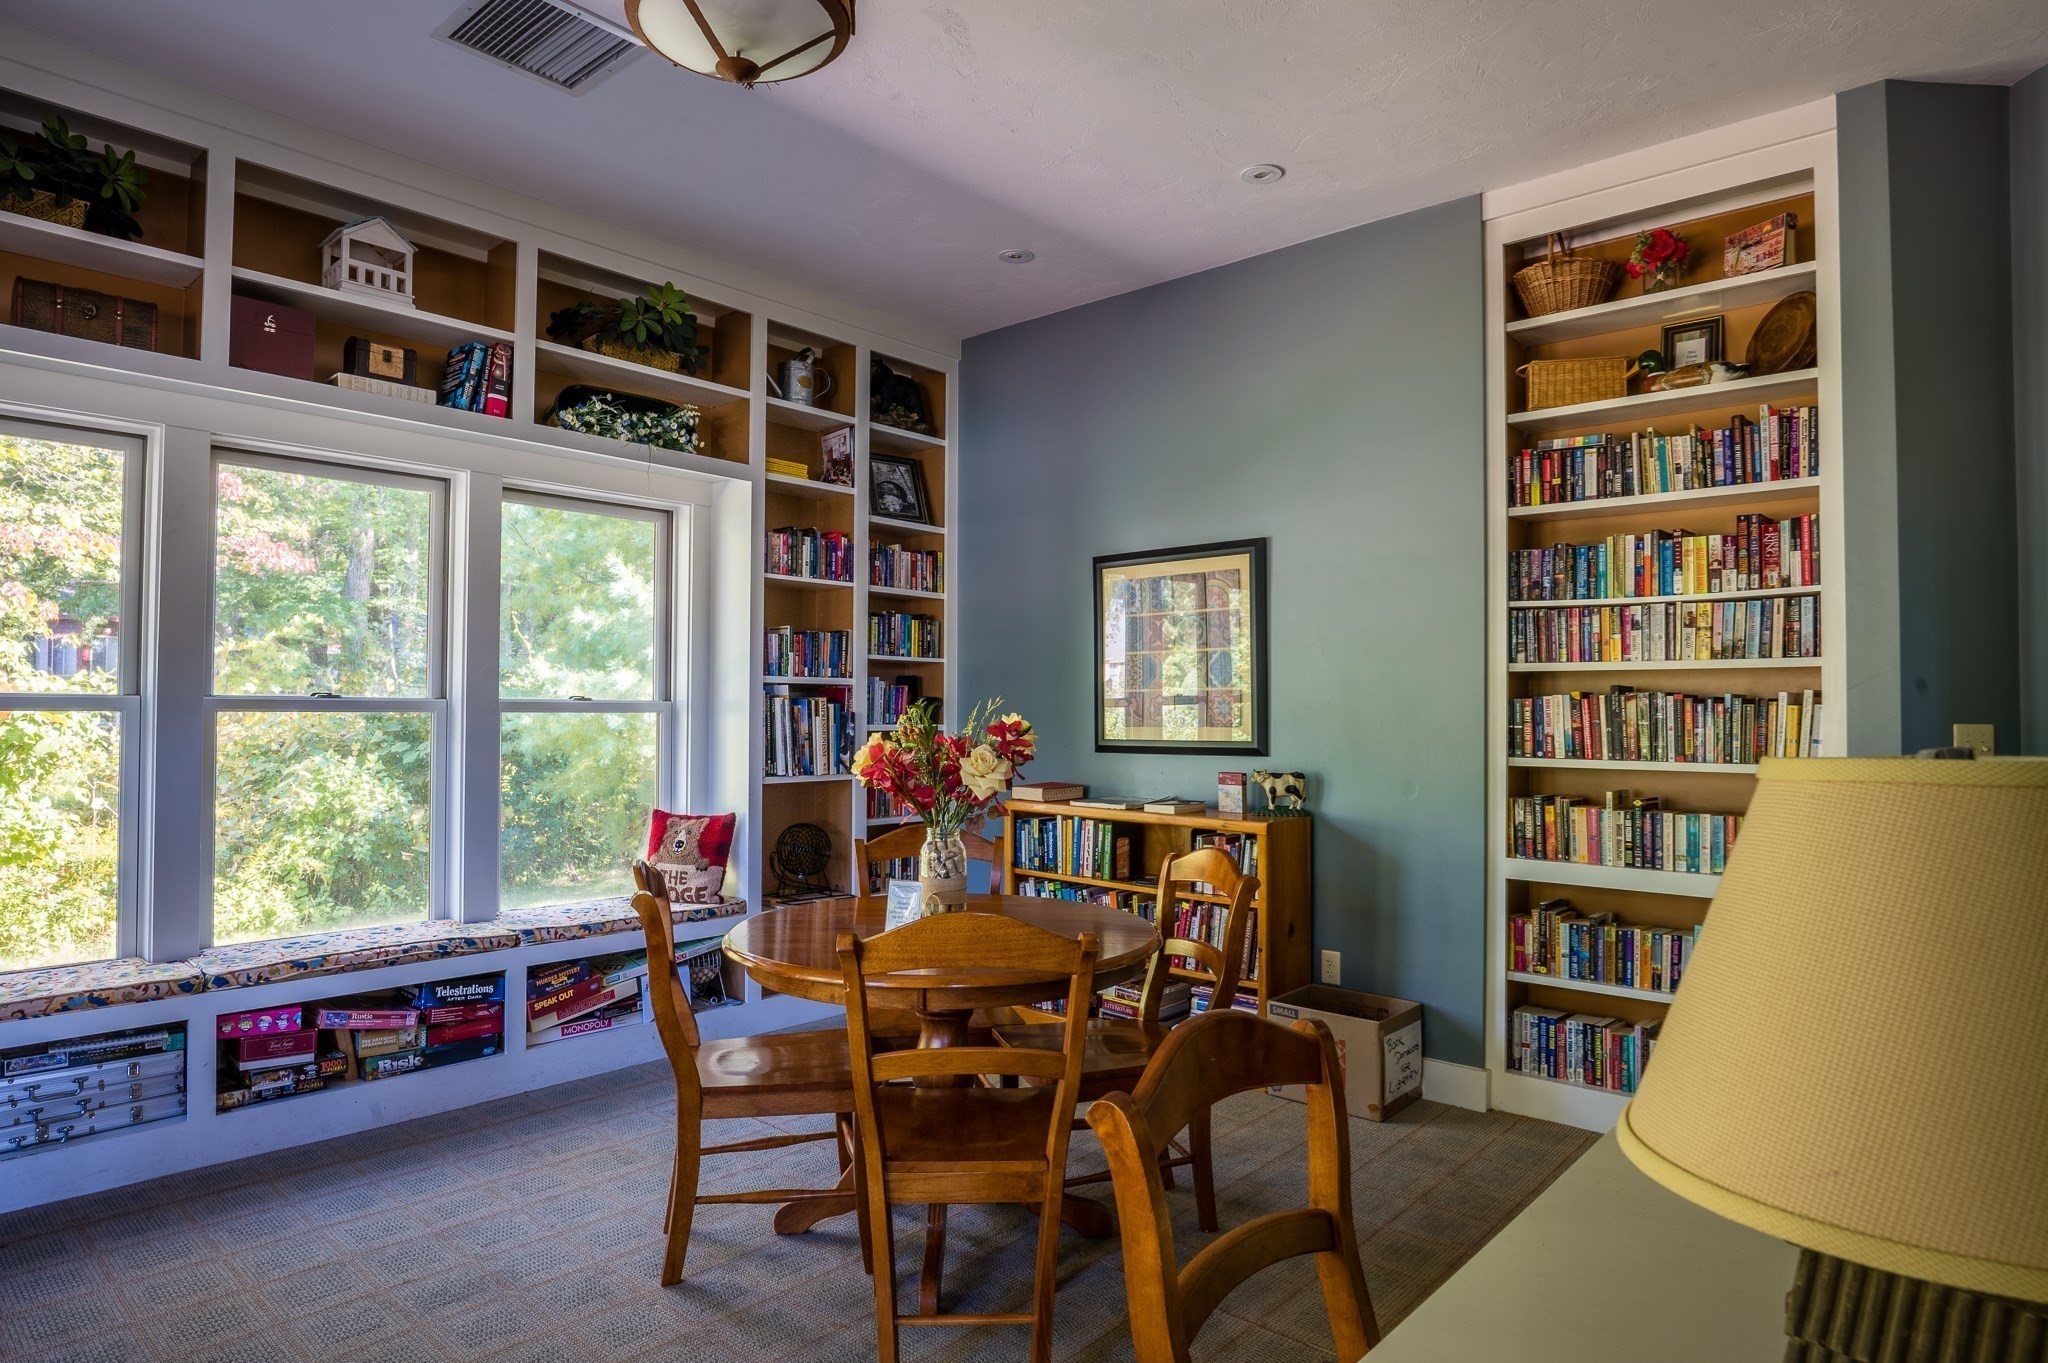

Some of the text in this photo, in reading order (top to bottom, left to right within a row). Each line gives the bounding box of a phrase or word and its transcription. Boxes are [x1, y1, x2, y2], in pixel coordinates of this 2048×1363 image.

[1763, 533, 1775, 557] KING
[536, 974, 558, 987] MURDER
[558, 966, 581, 978] MYSTERY
[435, 984, 494, 998] Telestrations
[534, 989, 574, 1011] SPEAK OUT
[559, 991, 612, 1019] MONOPOLY
[1104, 1002, 1133, 1014] LITERATURE
[1272, 1007, 1296, 1018] SMALL
[564, 1020, 609, 1035] MONOPOLY
[320, 1059, 342, 1073] 1000
